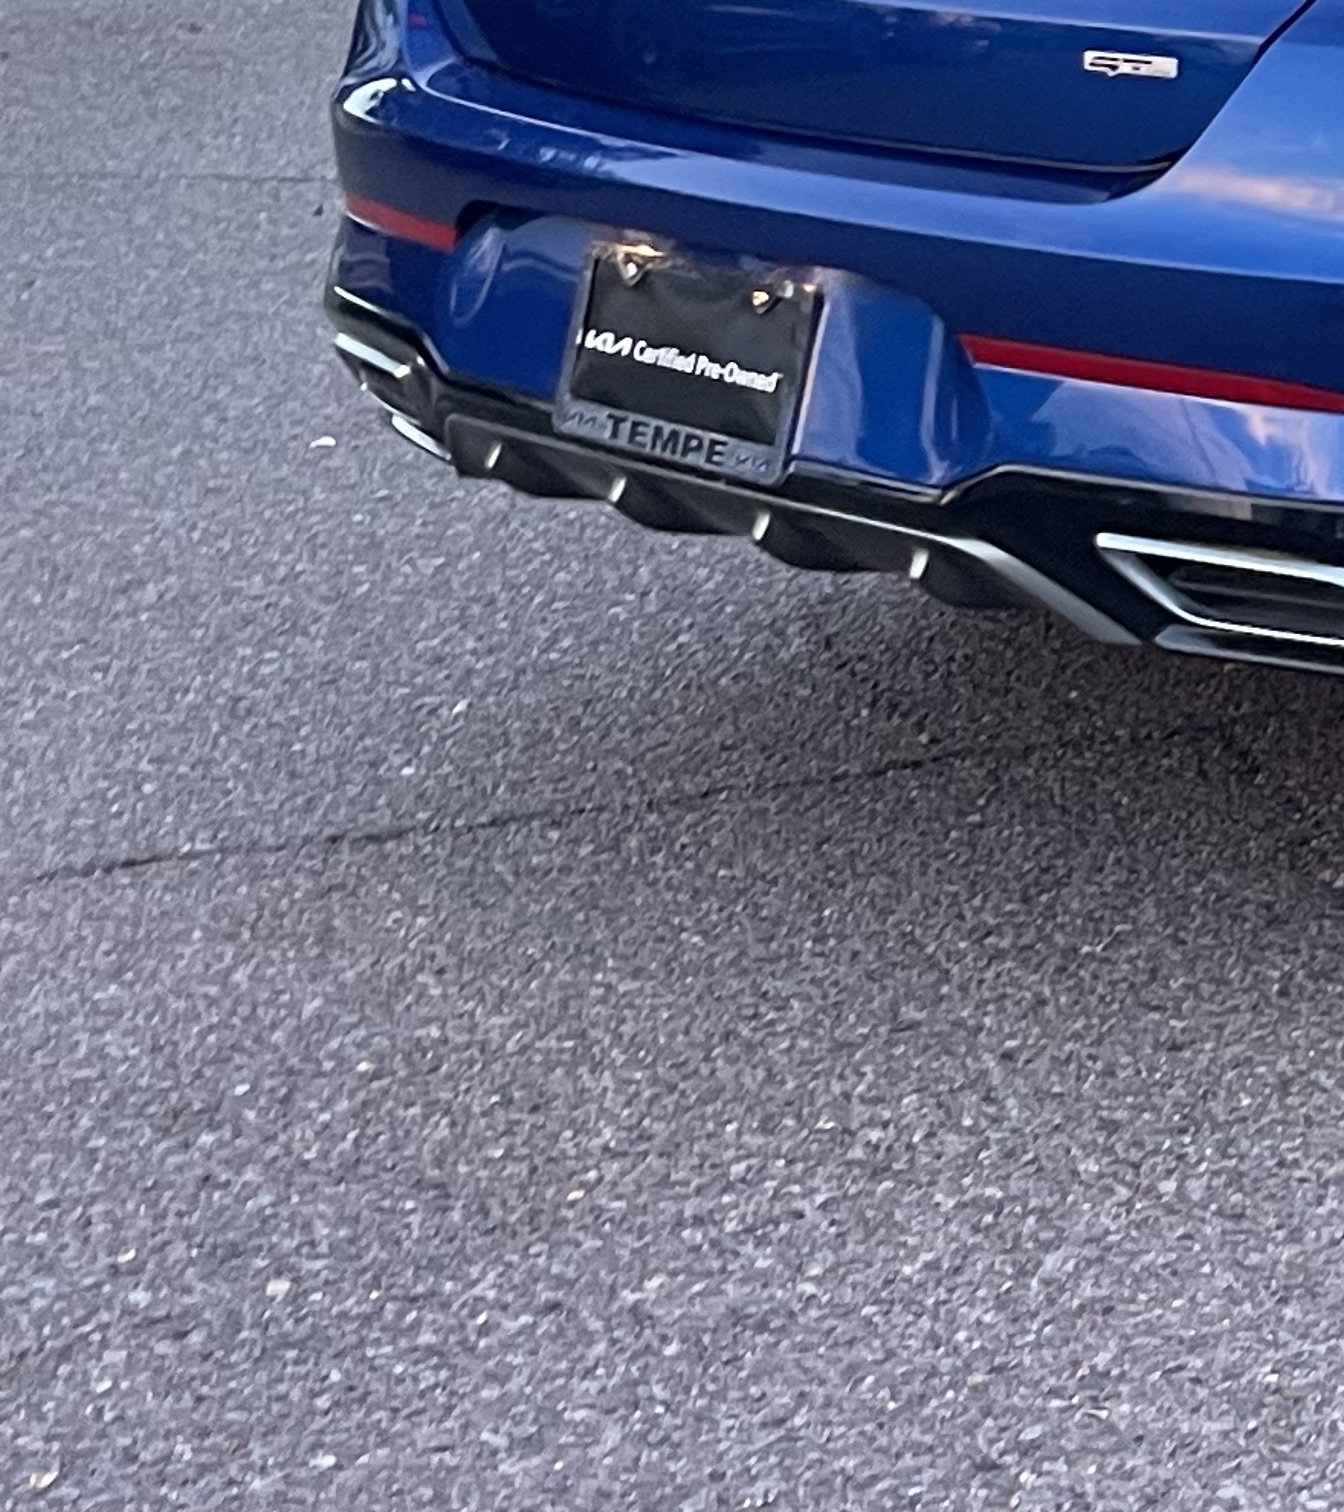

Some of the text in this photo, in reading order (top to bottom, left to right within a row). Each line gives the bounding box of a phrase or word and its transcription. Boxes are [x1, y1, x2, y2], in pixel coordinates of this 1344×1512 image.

[584, 329, 779, 392] KIA Certified Pre-Owned
[606, 413, 728, 466] TEMPE
